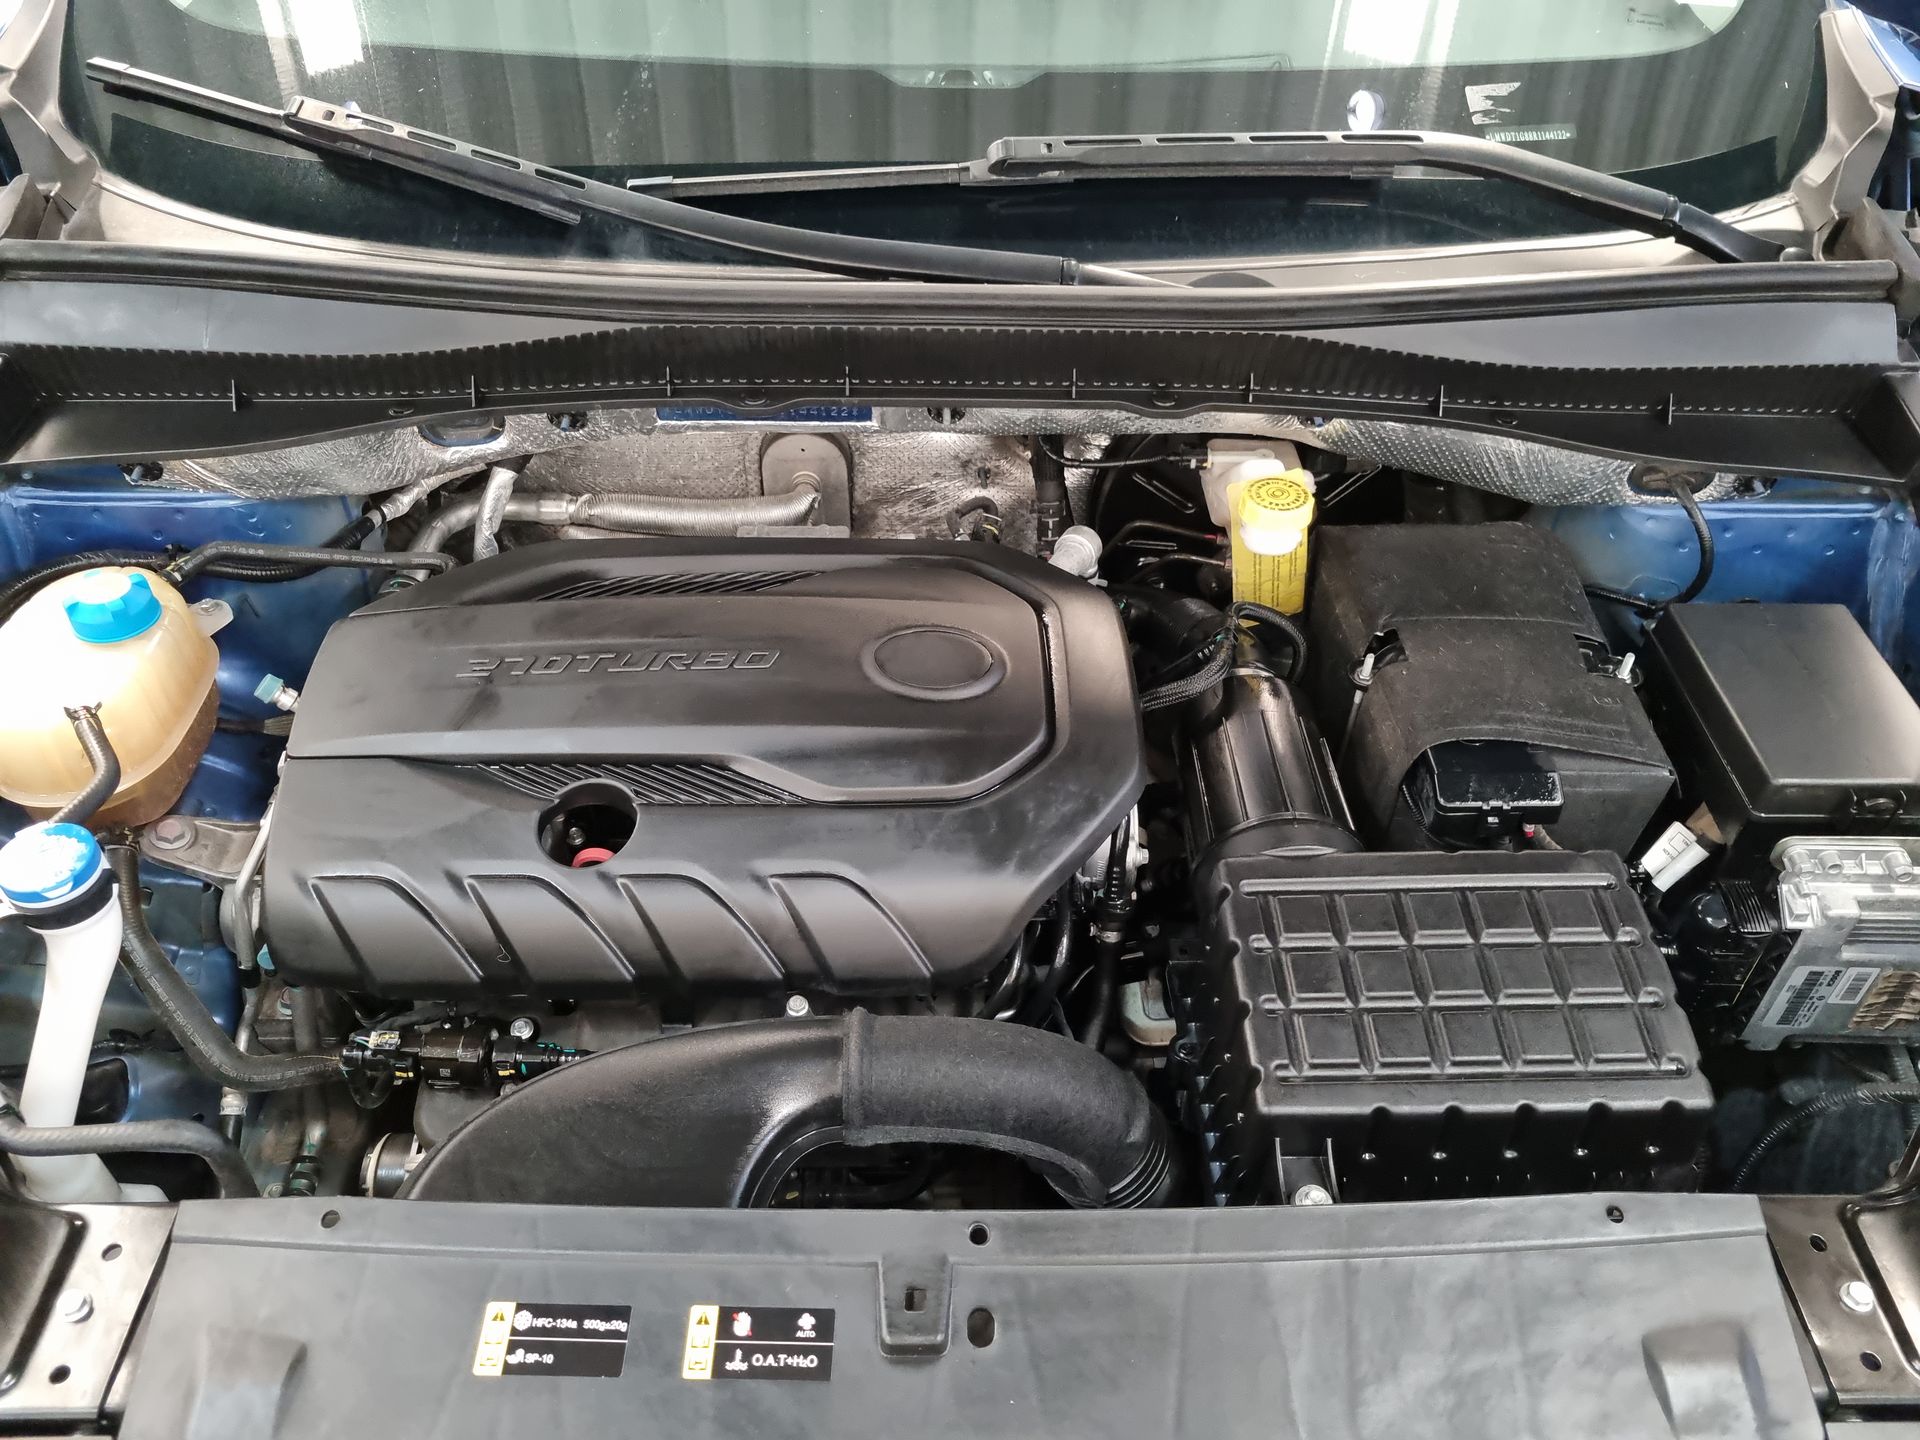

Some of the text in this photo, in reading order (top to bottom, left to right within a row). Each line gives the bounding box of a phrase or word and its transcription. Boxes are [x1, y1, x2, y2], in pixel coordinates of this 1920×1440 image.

[532, 1317, 578, 1329] HFC-134a
[795, 1330, 817, 1338] AUTO
[524, 1353, 555, 1364] SP-10
